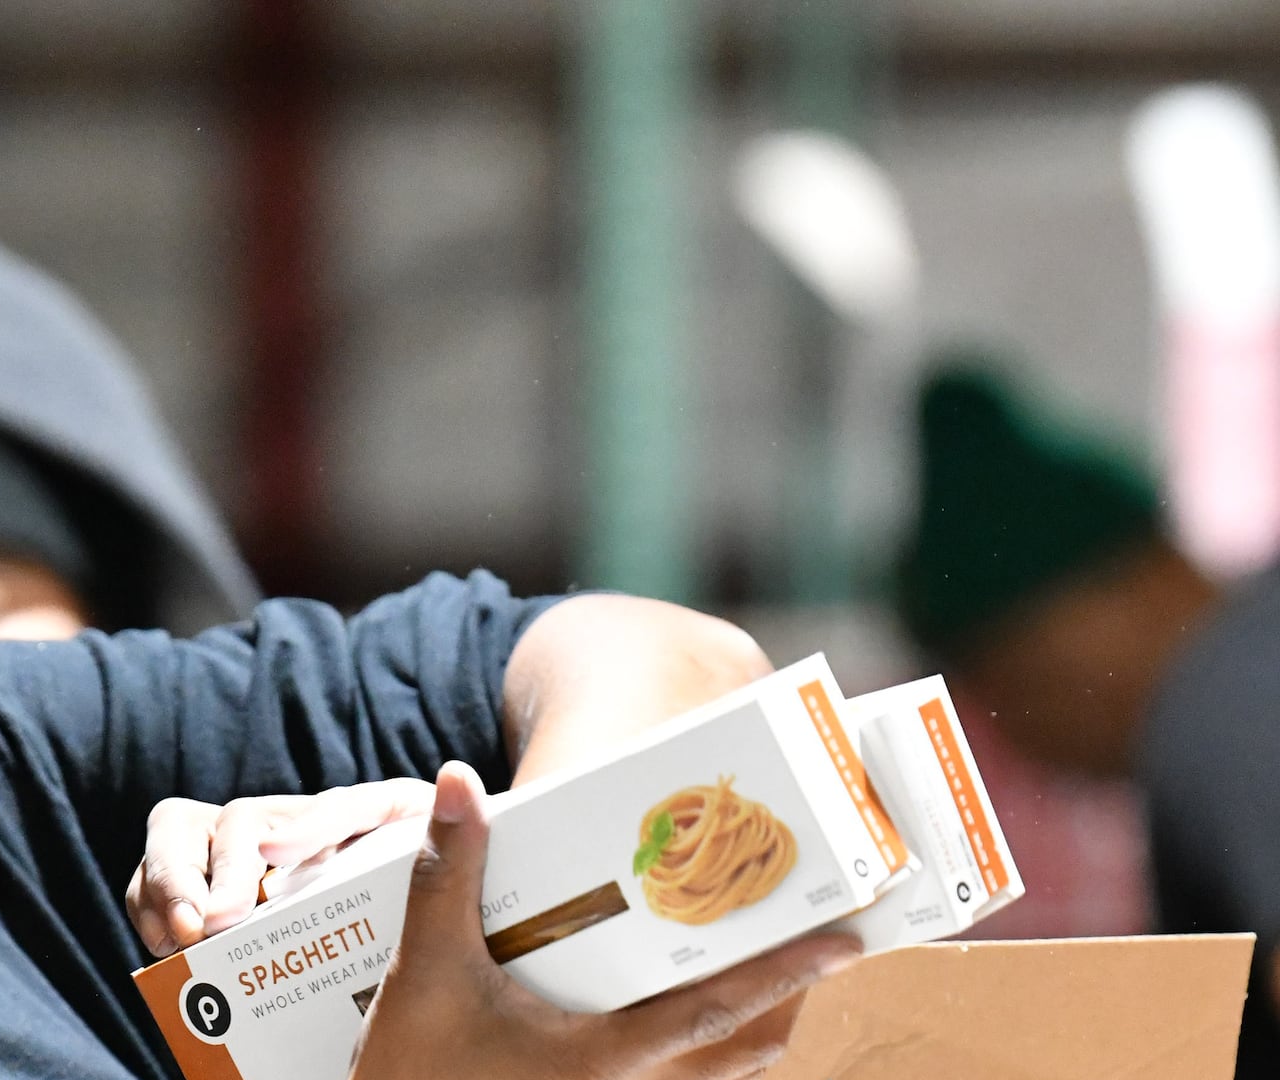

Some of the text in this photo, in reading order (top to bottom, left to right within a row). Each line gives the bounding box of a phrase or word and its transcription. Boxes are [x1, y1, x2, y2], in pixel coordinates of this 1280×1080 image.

[227, 889, 372, 963] 100% WHOLE GRAIN
[238, 917, 376, 996] SPAGHETTI
[251, 987, 305, 1019] WHOLE
[308, 962, 358, 994] WHEAT
